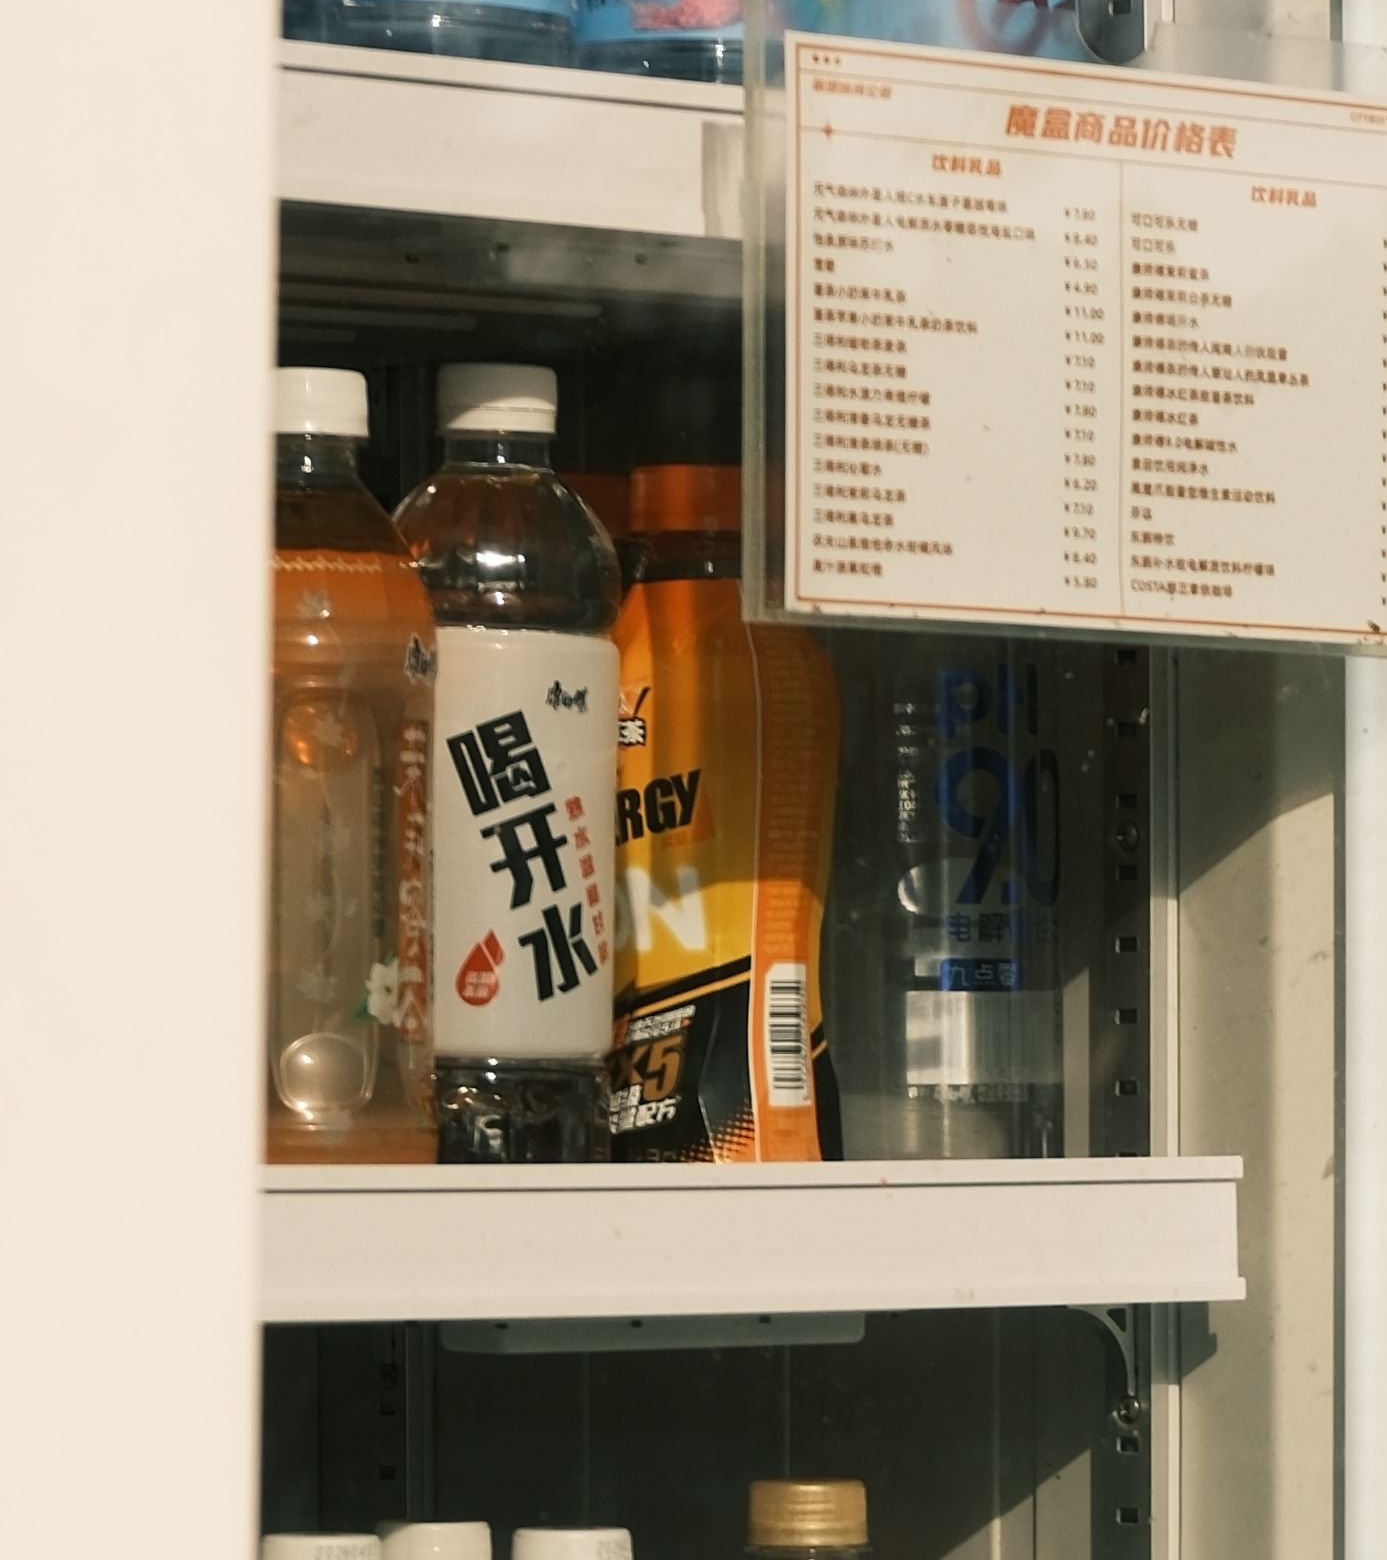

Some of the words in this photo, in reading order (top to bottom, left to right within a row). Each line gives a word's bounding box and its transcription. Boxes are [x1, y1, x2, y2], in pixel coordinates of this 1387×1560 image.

[1004, 103, 1238, 159] 魔盒商品价格表
[931, 154, 1001, 176] 饮料乳品
[1251, 186, 1318, 208] 饮料乳品
[616, 769, 702, 847] RGY
[446, 709, 599, 1003] 喝开水
